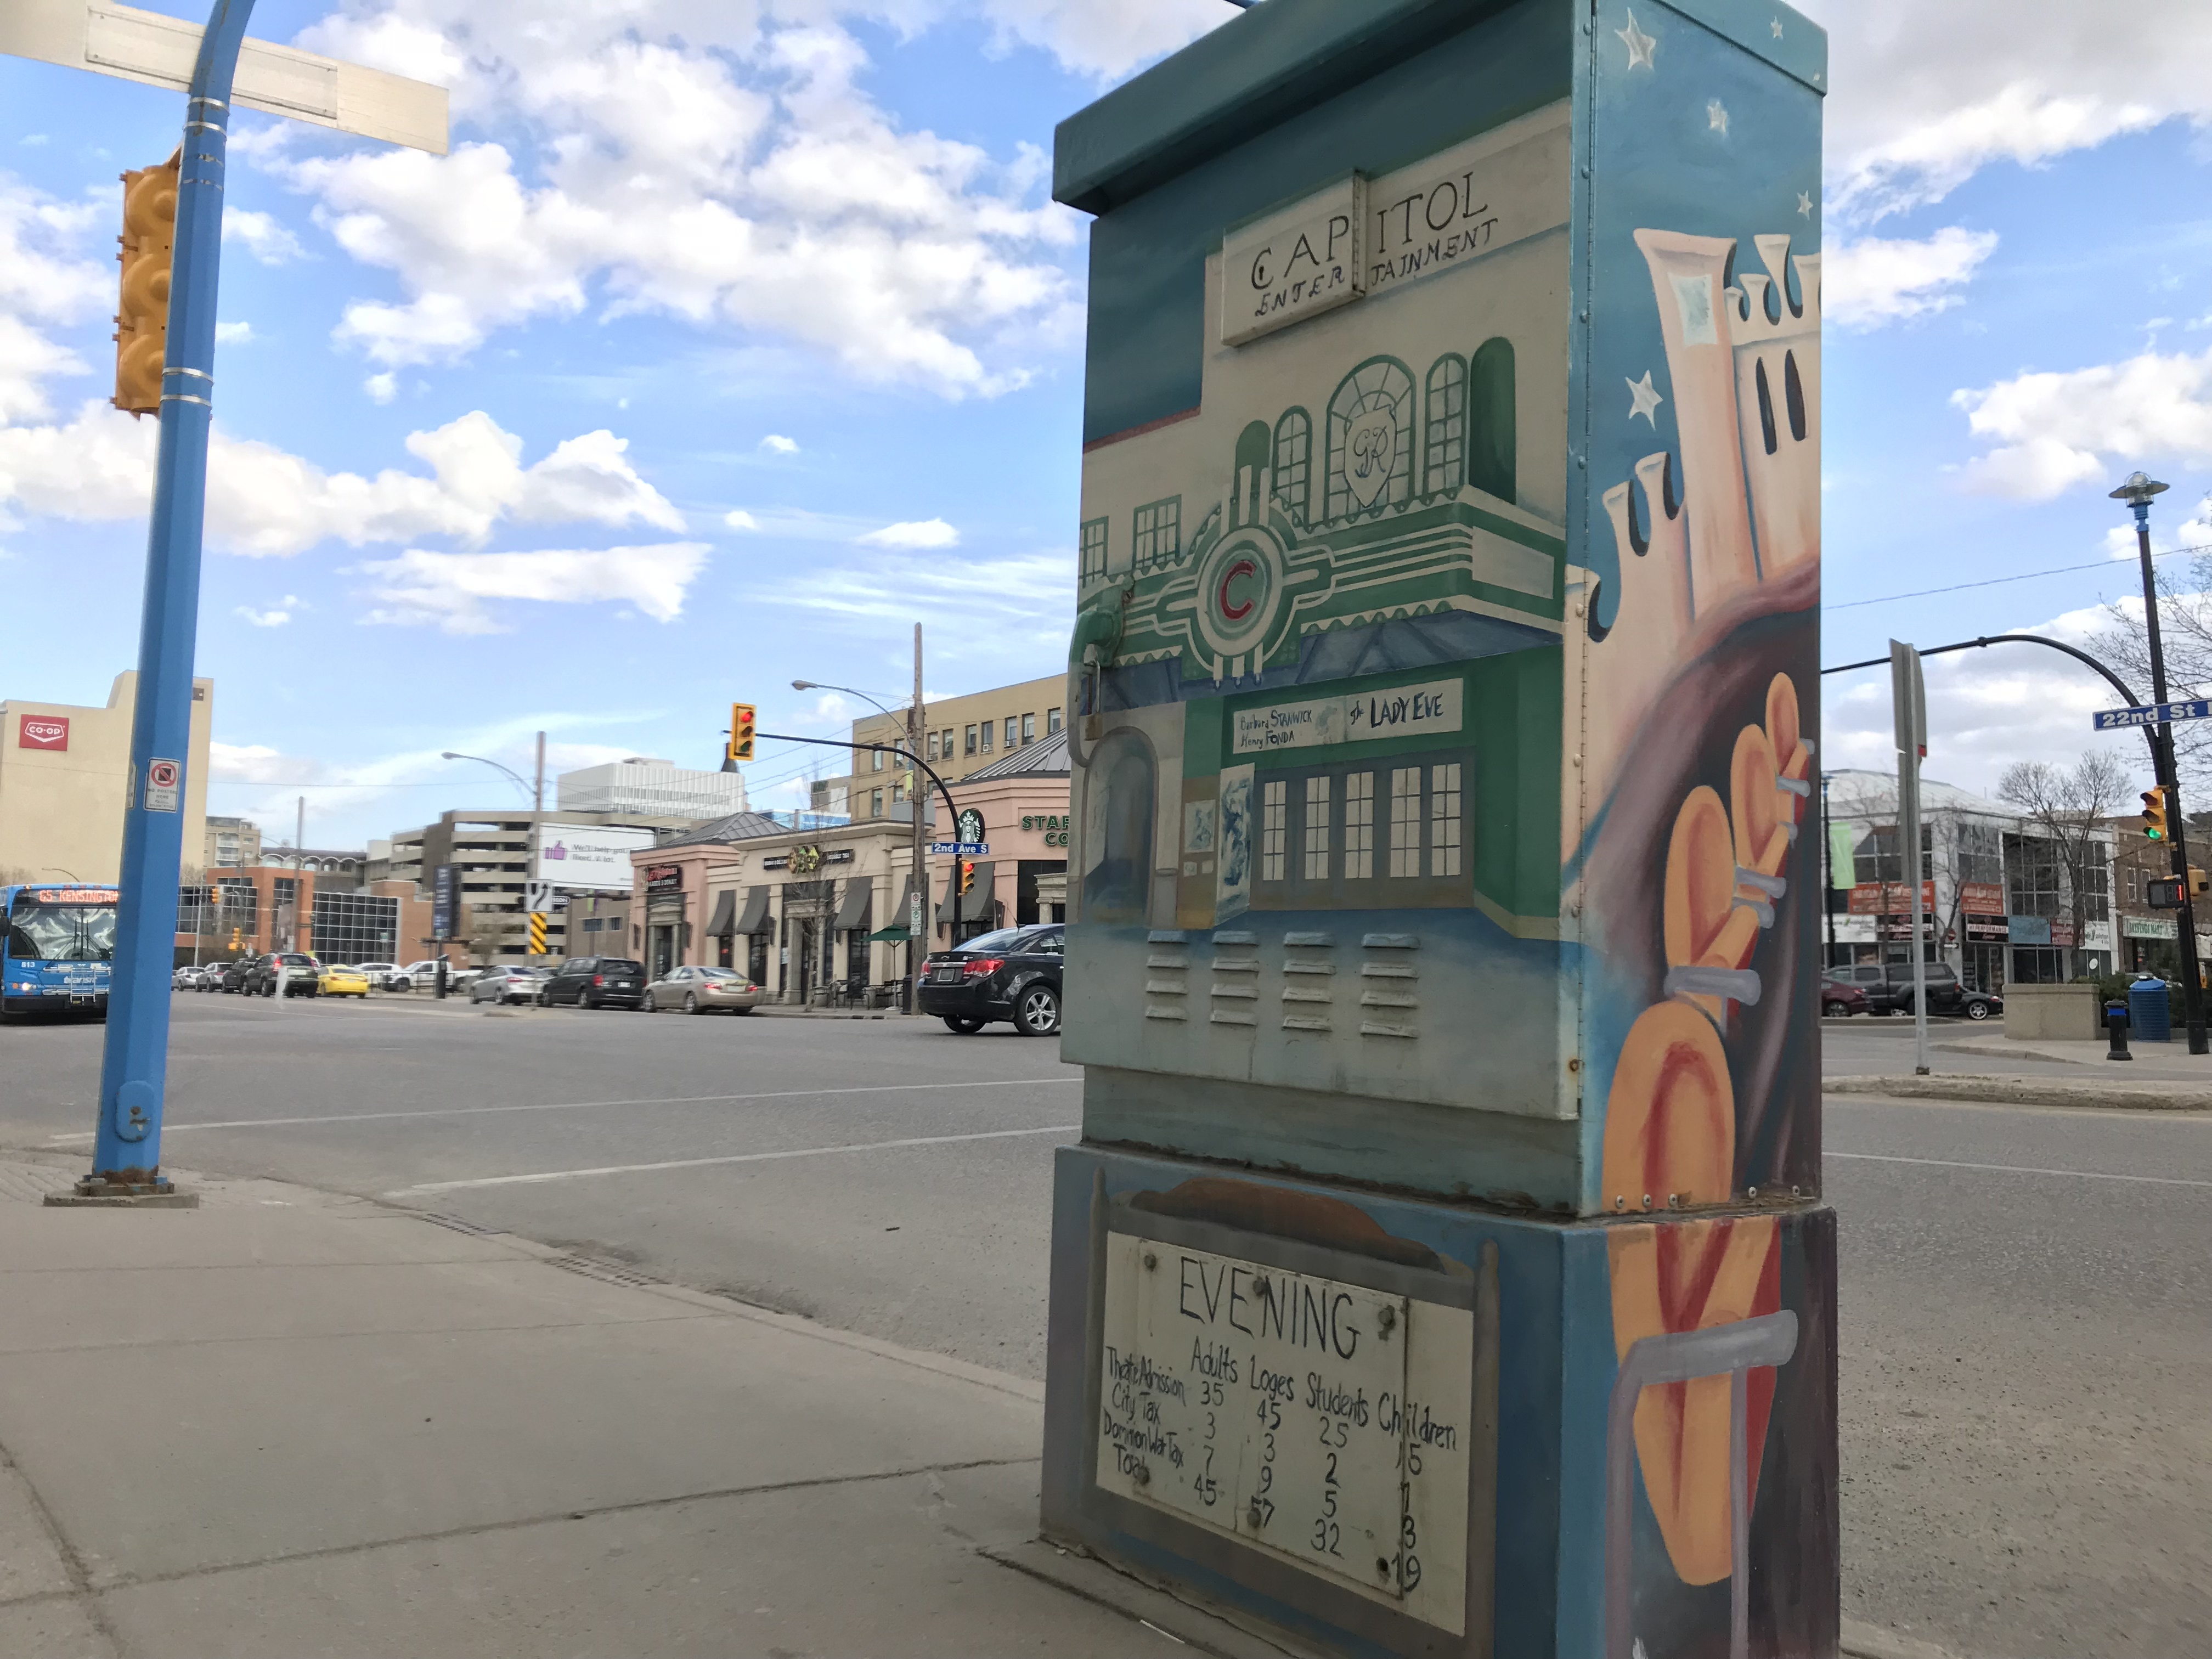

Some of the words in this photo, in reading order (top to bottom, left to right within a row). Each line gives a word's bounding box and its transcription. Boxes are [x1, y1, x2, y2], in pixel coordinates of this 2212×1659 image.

[1220, 559, 1257, 621] C
[1240, 713, 1269, 731] Barbara
[1271, 709, 1312, 727] STANWYCK
[1240, 732, 1263, 749] Henry
[1266, 730, 1295, 745] FONDA
[1371, 697, 1410, 728] LADY
[1413, 691, 1444, 720] EVE
[2102, 708, 2159, 727] 22nd
[2170, 704, 2196, 719] St
[934, 843, 953, 853] 2nd
[958, 844, 977, 853] Ave
[980, 844, 988, 854] S
[1180, 1256, 1361, 1359] EVENING
[1191, 1335, 1238, 1383] Adults
[1250, 1355, 1294, 1402] Loges
[1306, 1373, 1368, 1427] Students
[1378, 1392, 1457, 1451] Children
[1200, 1380, 1224, 1407] 35
[1256, 1398, 1282, 1430] 45
[1319, 1415, 1349, 1448] 25
[1112, 1381, 1136, 1421] City
[1138, 1392, 1161, 1425] Tax
[1204, 1412, 1216, 1440] 3
[1263, 1432, 1276, 1463] 3
[1324, 1452, 1341, 1489] 2
[1165, 1431, 1184, 1469] Tax
[1203, 1444, 1215, 1476] 7
[1260, 1465, 1272, 1493] 9
[1322, 1490, 1337, 1519] 5
[1402, 1515, 1416, 1549] 3
[1194, 1474, 1217, 1506] 45
[1310, 1519, 1345, 1560] 32
[1391, 1552, 1421, 1593] 19
